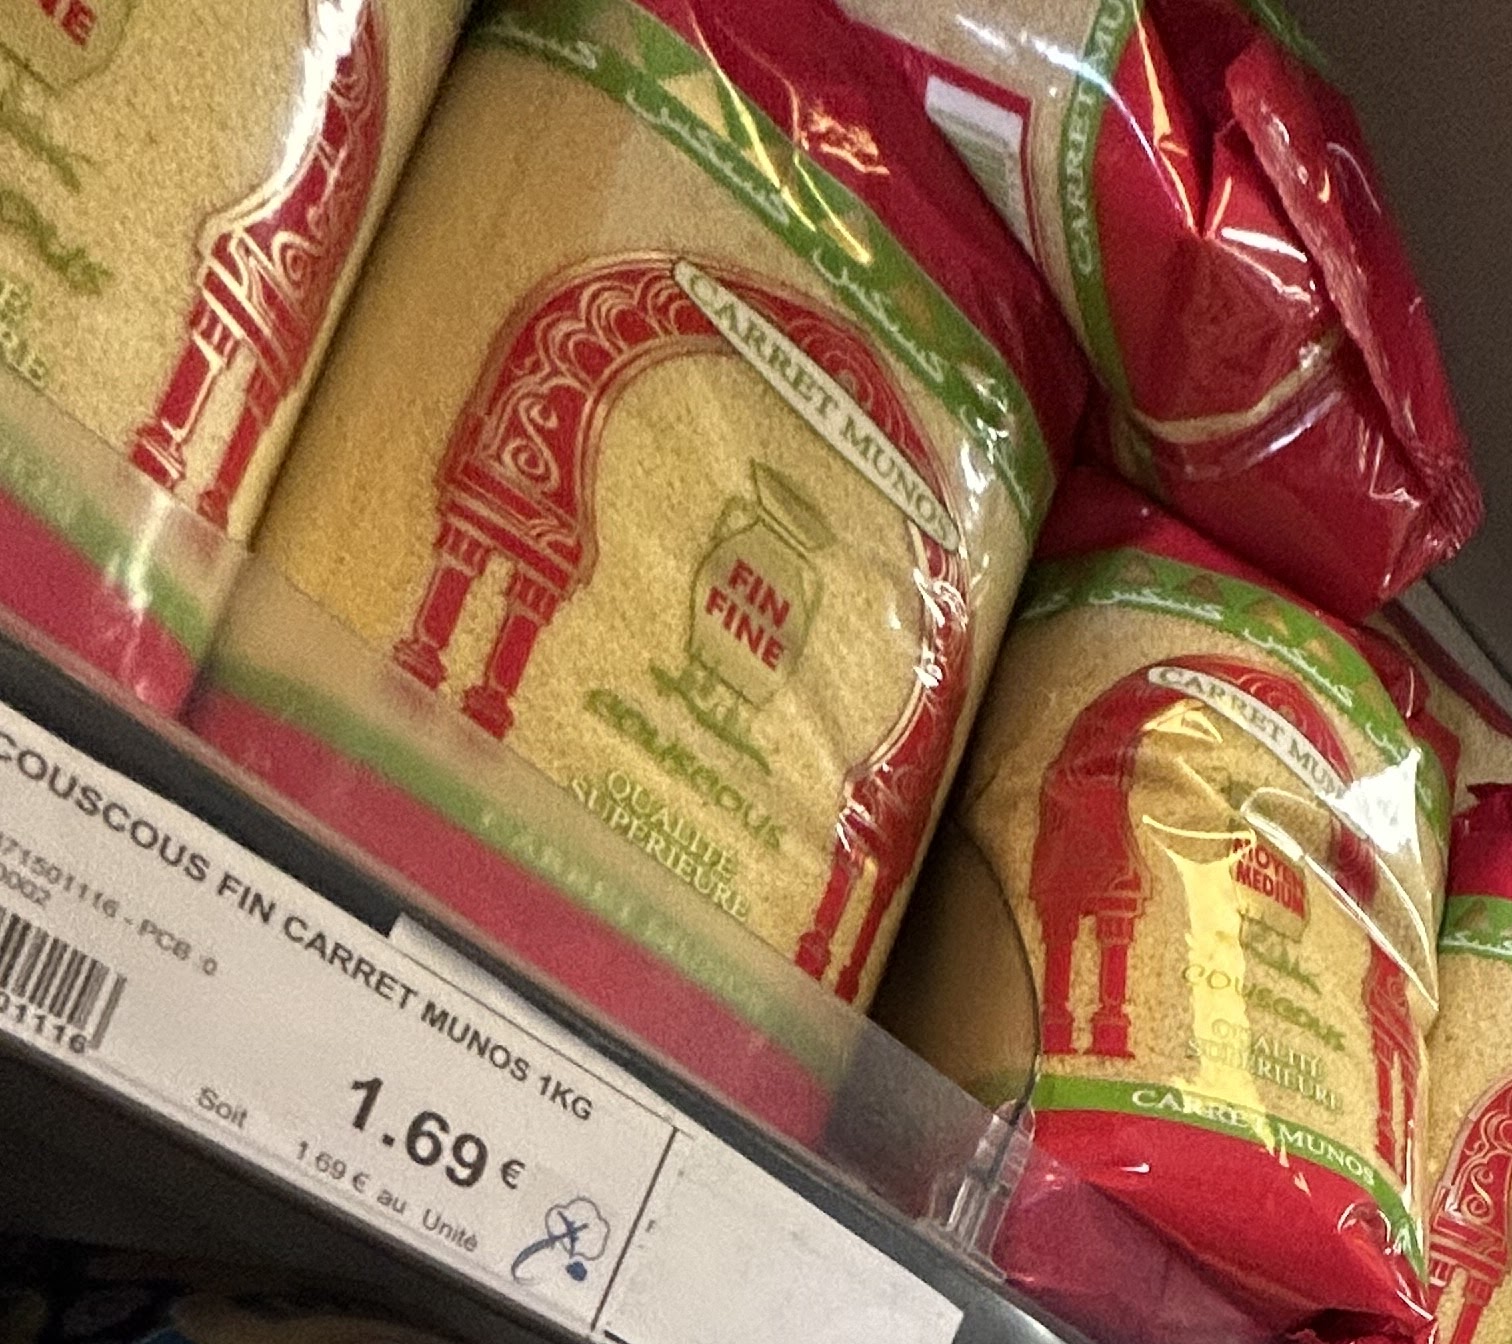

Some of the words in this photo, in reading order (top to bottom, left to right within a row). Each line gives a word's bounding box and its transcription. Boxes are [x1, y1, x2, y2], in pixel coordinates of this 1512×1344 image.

[687, 268, 843, 422] CARRET
[840, 416, 958, 541] MUNOS
[704, 584, 789, 672] FINE
[727, 557, 793, 628] FIN
[1158, 666, 1282, 749] CARRET
[217, 870, 277, 925] FIN
[283, 916, 419, 1009] CARRET
[420, 1000, 532, 1081] MUNOS
[538, 1074, 594, 1121] 1KG
[196, 1085, 250, 1129] Soit
[377, 1187, 407, 1217] au
[350, 1075, 489, 1190] 1.69
[501, 1158, 526, 1190] €
[1277, 1123, 1376, 1187] MUNOS
